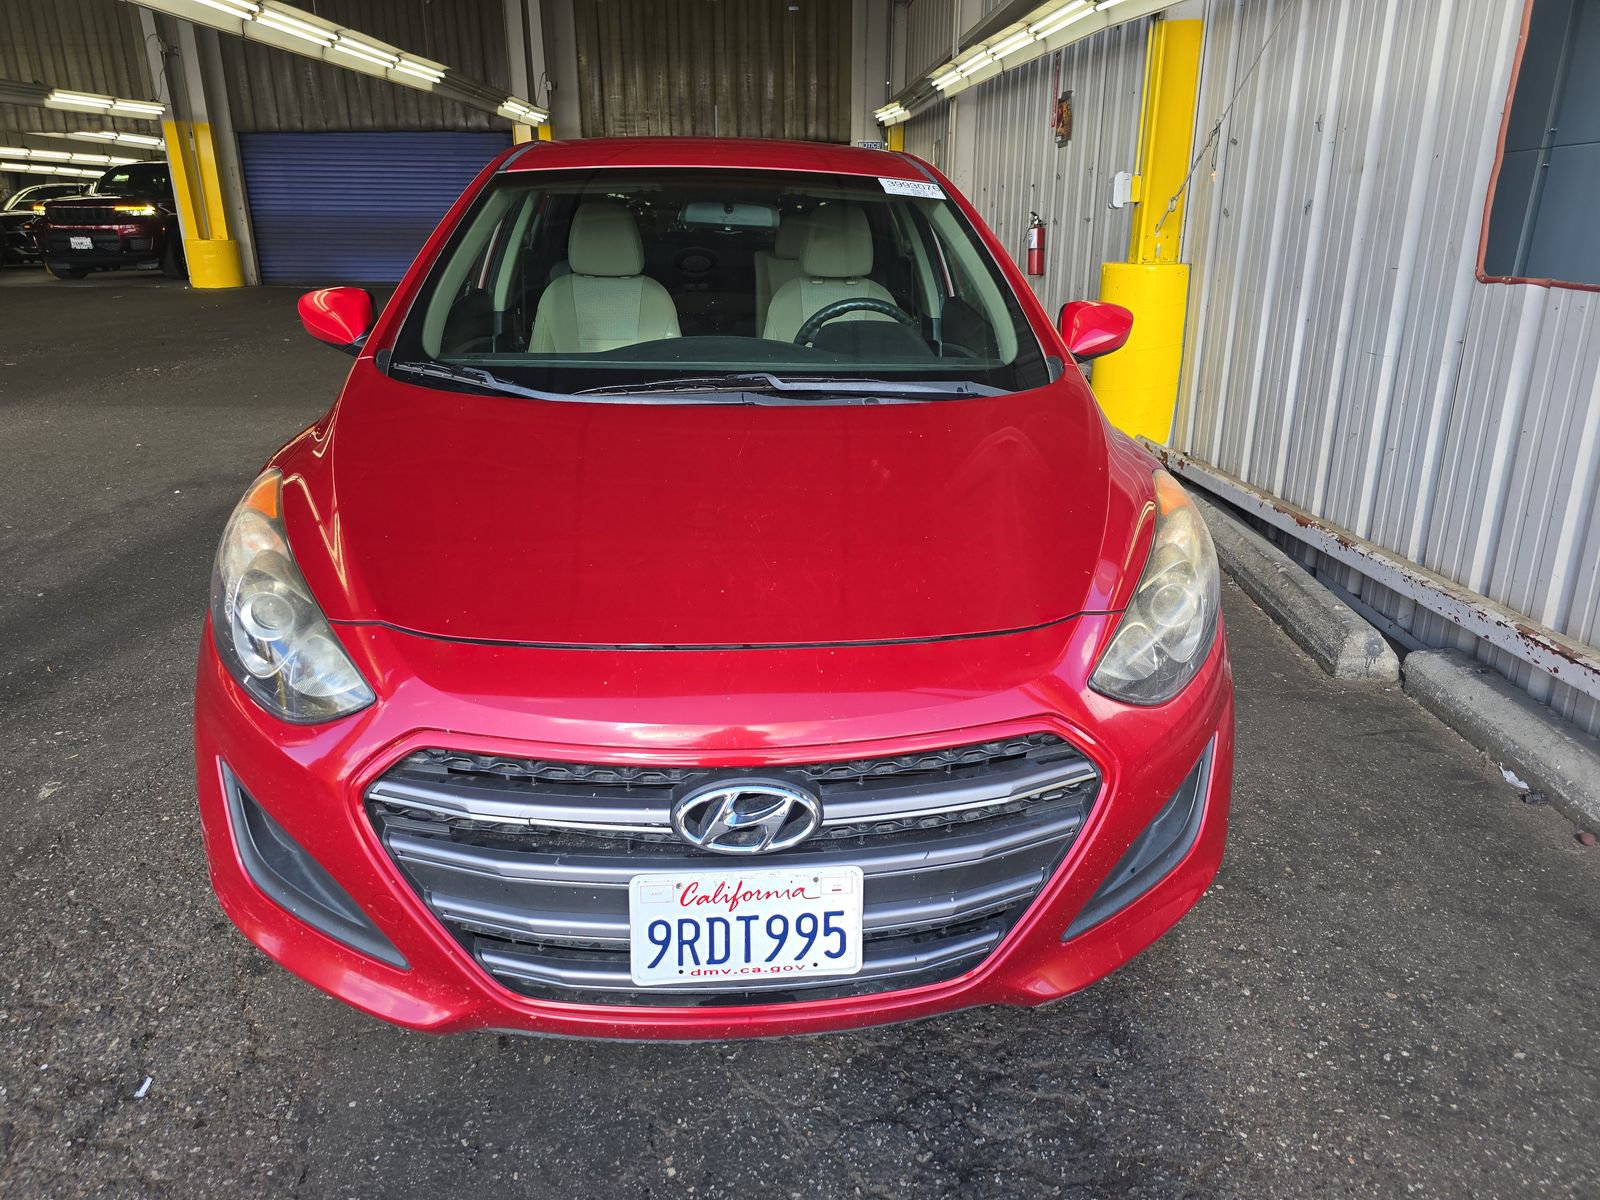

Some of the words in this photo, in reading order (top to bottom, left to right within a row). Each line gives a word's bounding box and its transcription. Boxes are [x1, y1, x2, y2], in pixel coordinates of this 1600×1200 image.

[679, 880, 821, 912] California
[647, 910, 847, 969] 9RDT995
[690, 964, 806, 977] dmv.ca.gov
